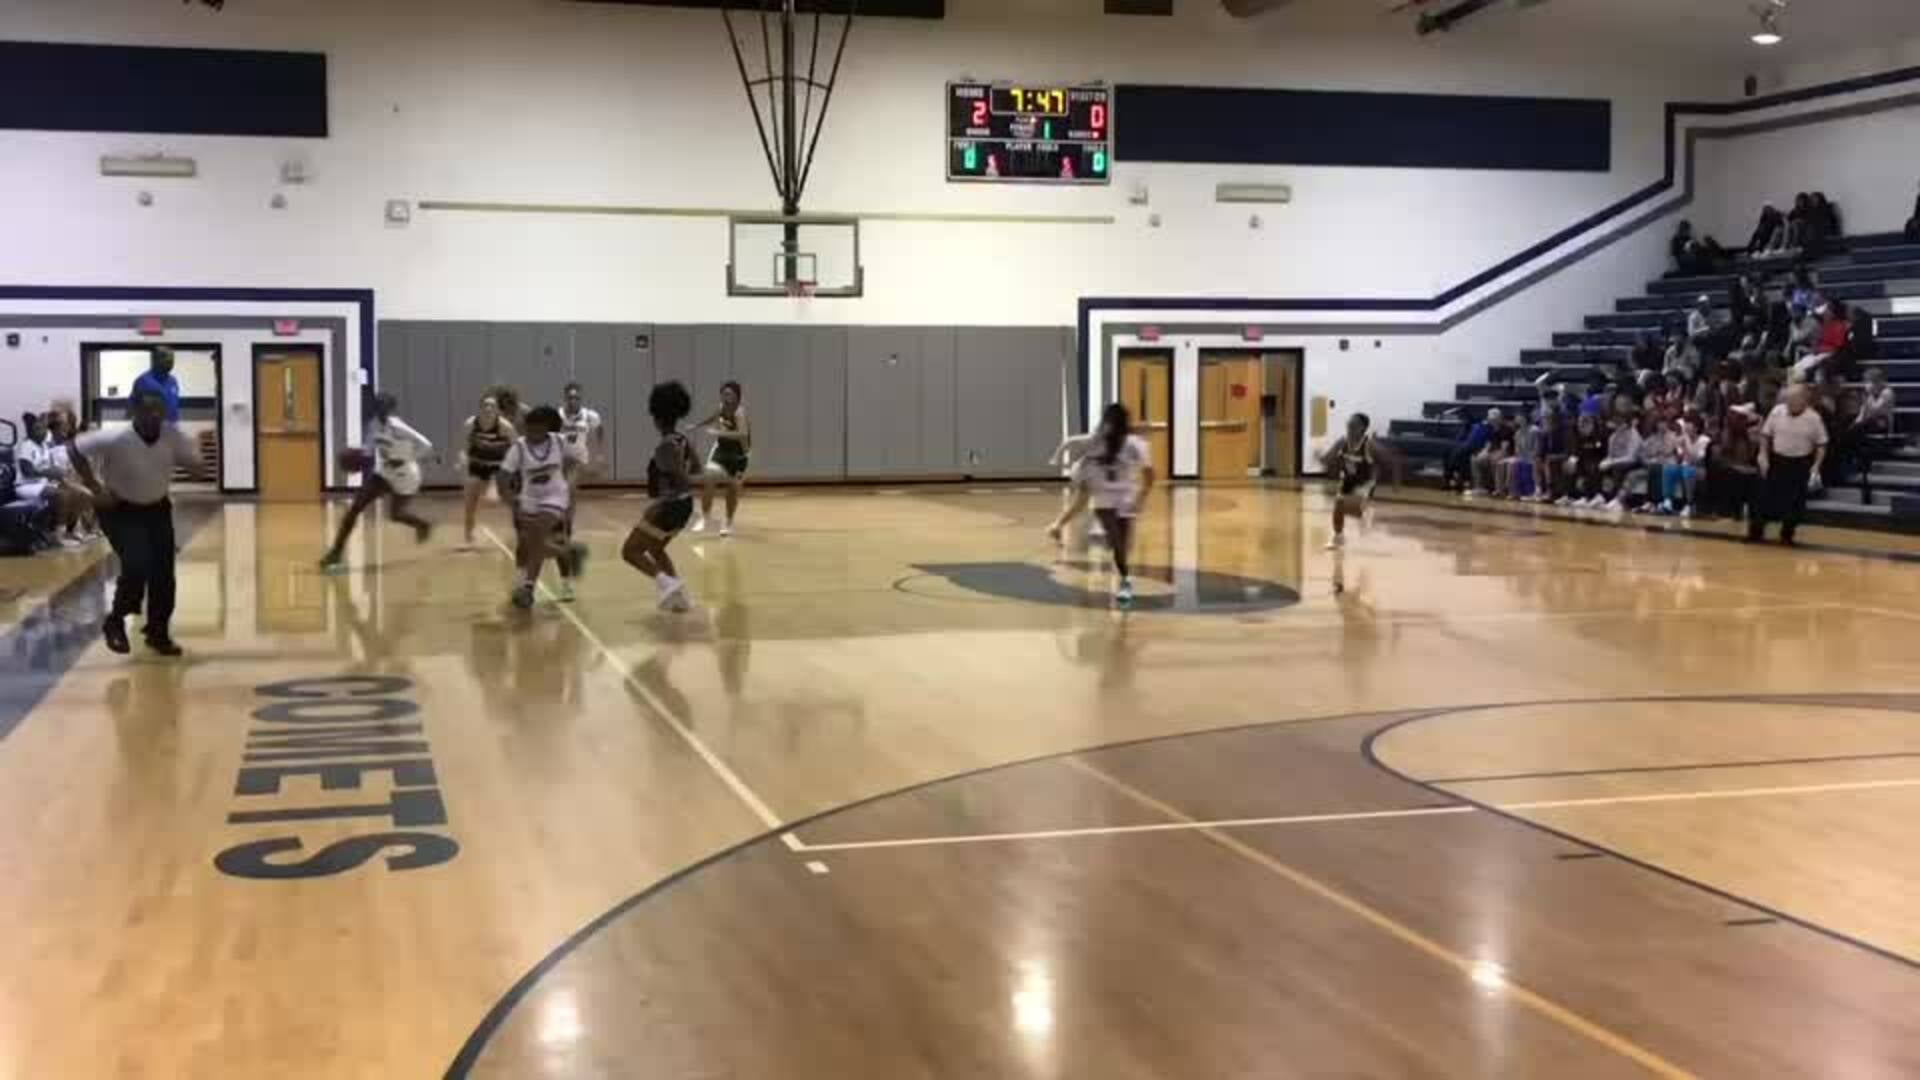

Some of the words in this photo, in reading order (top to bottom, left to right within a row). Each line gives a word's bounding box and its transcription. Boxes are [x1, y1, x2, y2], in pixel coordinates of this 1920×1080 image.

[1010, 88, 1063, 113] 7:47
[973, 101, 987, 125] 2
[1090, 105, 1104, 128] 0
[213, 674, 460, 880] COMETS
